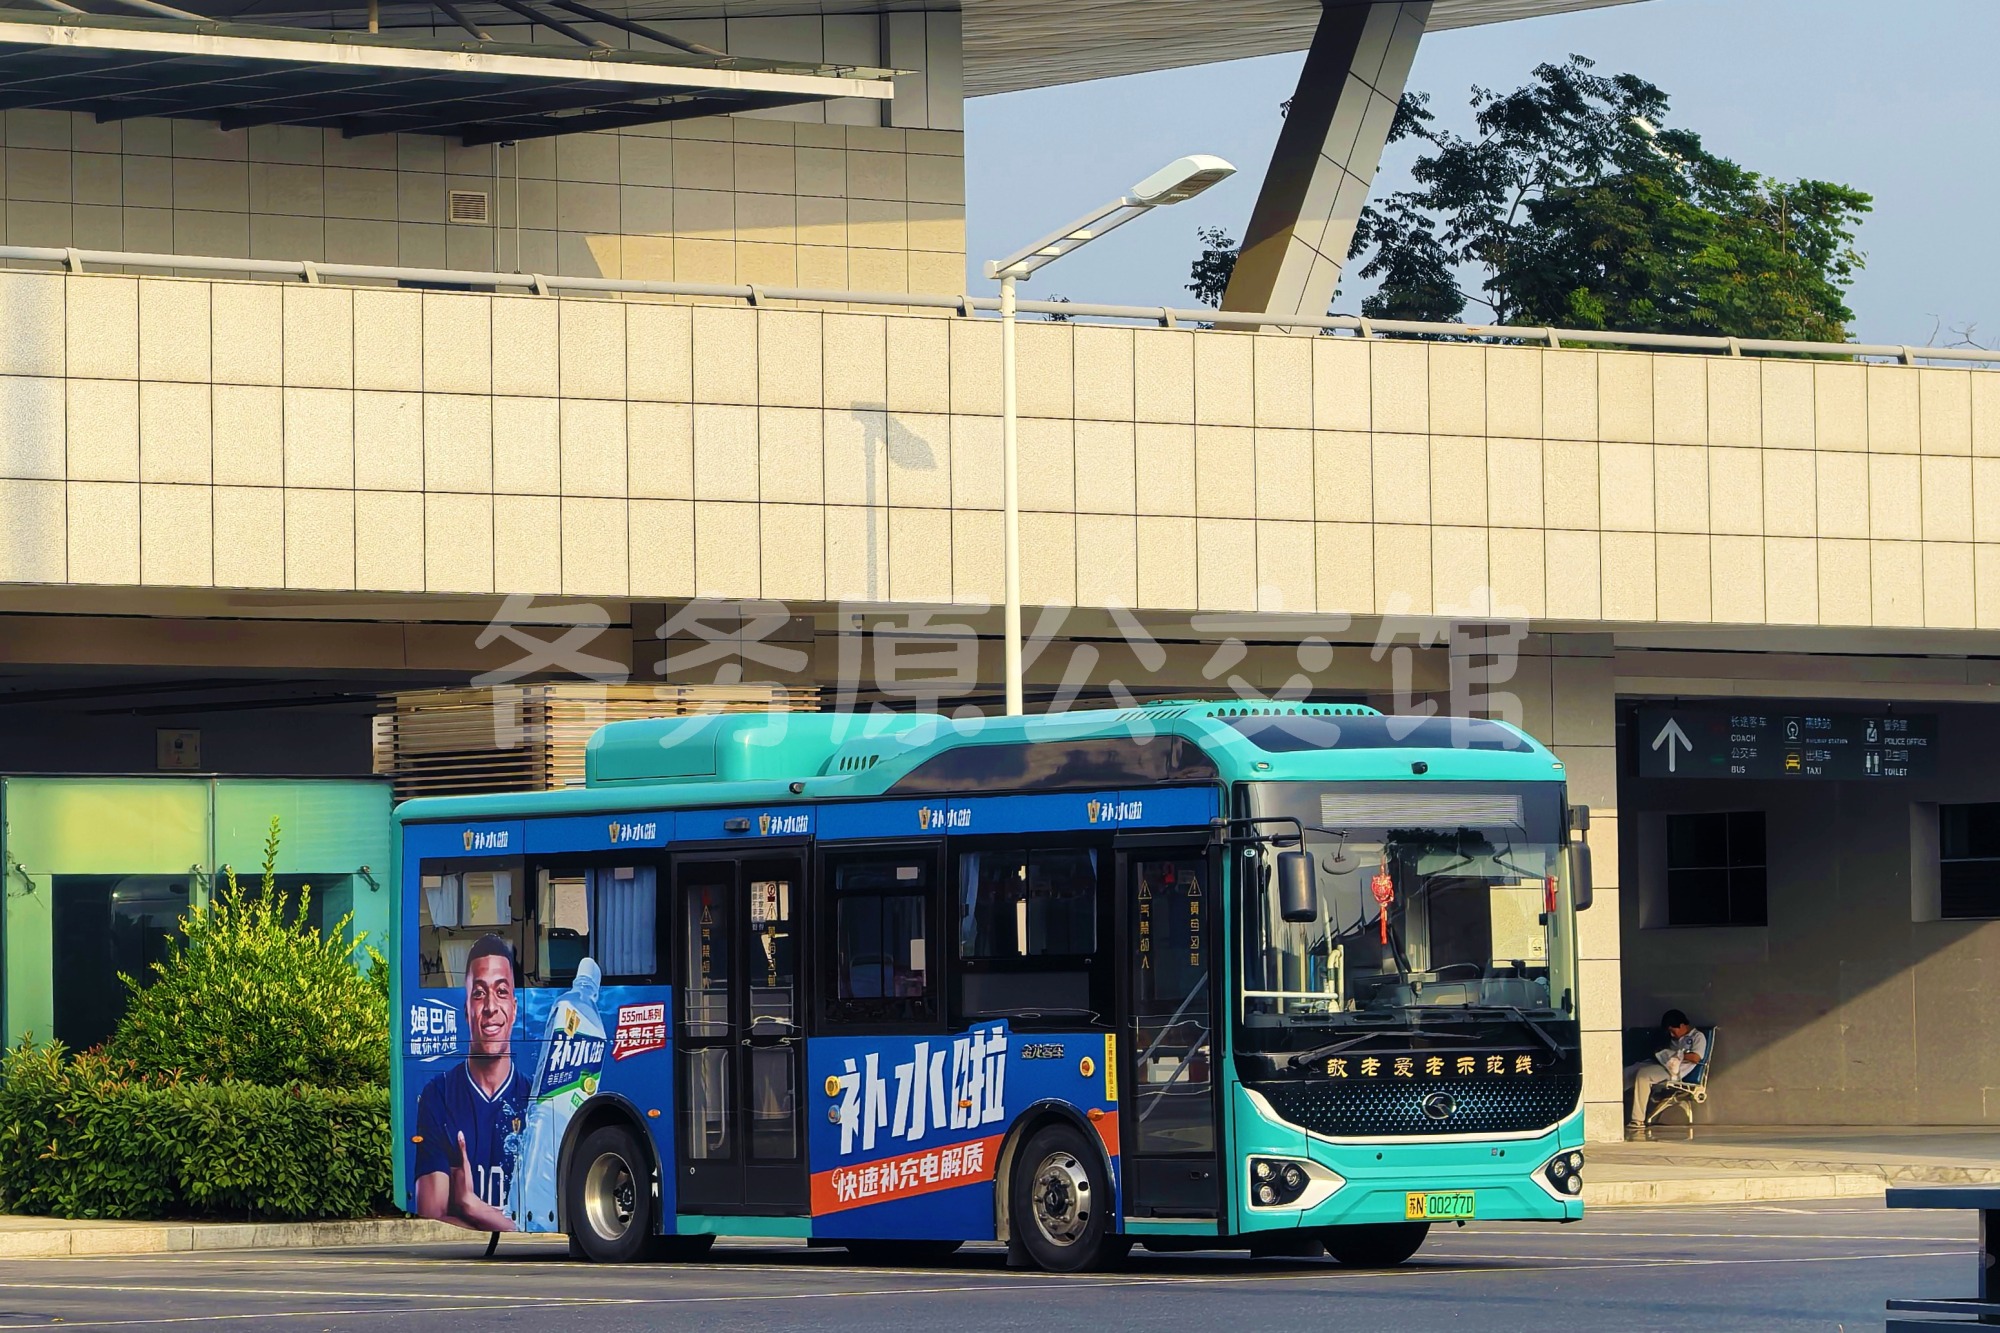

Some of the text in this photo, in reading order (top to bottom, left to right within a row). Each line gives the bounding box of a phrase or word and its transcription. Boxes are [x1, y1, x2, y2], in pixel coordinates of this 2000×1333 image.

[1731, 716, 1767, 728] 长途客车
[1731, 734, 1756, 742] COACH
[1906, 738, 1927, 746] OFFICE
[1731, 747, 1758, 759] 公交车
[1806, 749, 1831, 761] 出租车
[1884, 750, 1908, 762] 卫生间
[1731, 765, 1746, 773] BUS
[1884, 768, 1907, 776] TOILET
[931, 808, 971, 828] 补水啦
[1101, 801, 1142, 821] 补水啦
[621, 822, 656, 842] 补水啦
[771, 814, 808, 835] 补水啦
[474, 830, 509, 849] 补水啦
[411, 1004, 457, 1035] 姆巴佩
[621, 1009, 662, 1023] 555mL系列
[411, 1035, 457, 1055] 喊你补水啦
[612, 1024, 666, 1055] 免费乐享
[549, 1033, 605, 1071] 补水啦
[1326, 1054, 1533, 1078] 敬老爱老示范线
[838, 1026, 1008, 1155] 补水啦
[837, 1142, 985, 1203] 快速补充电解质
